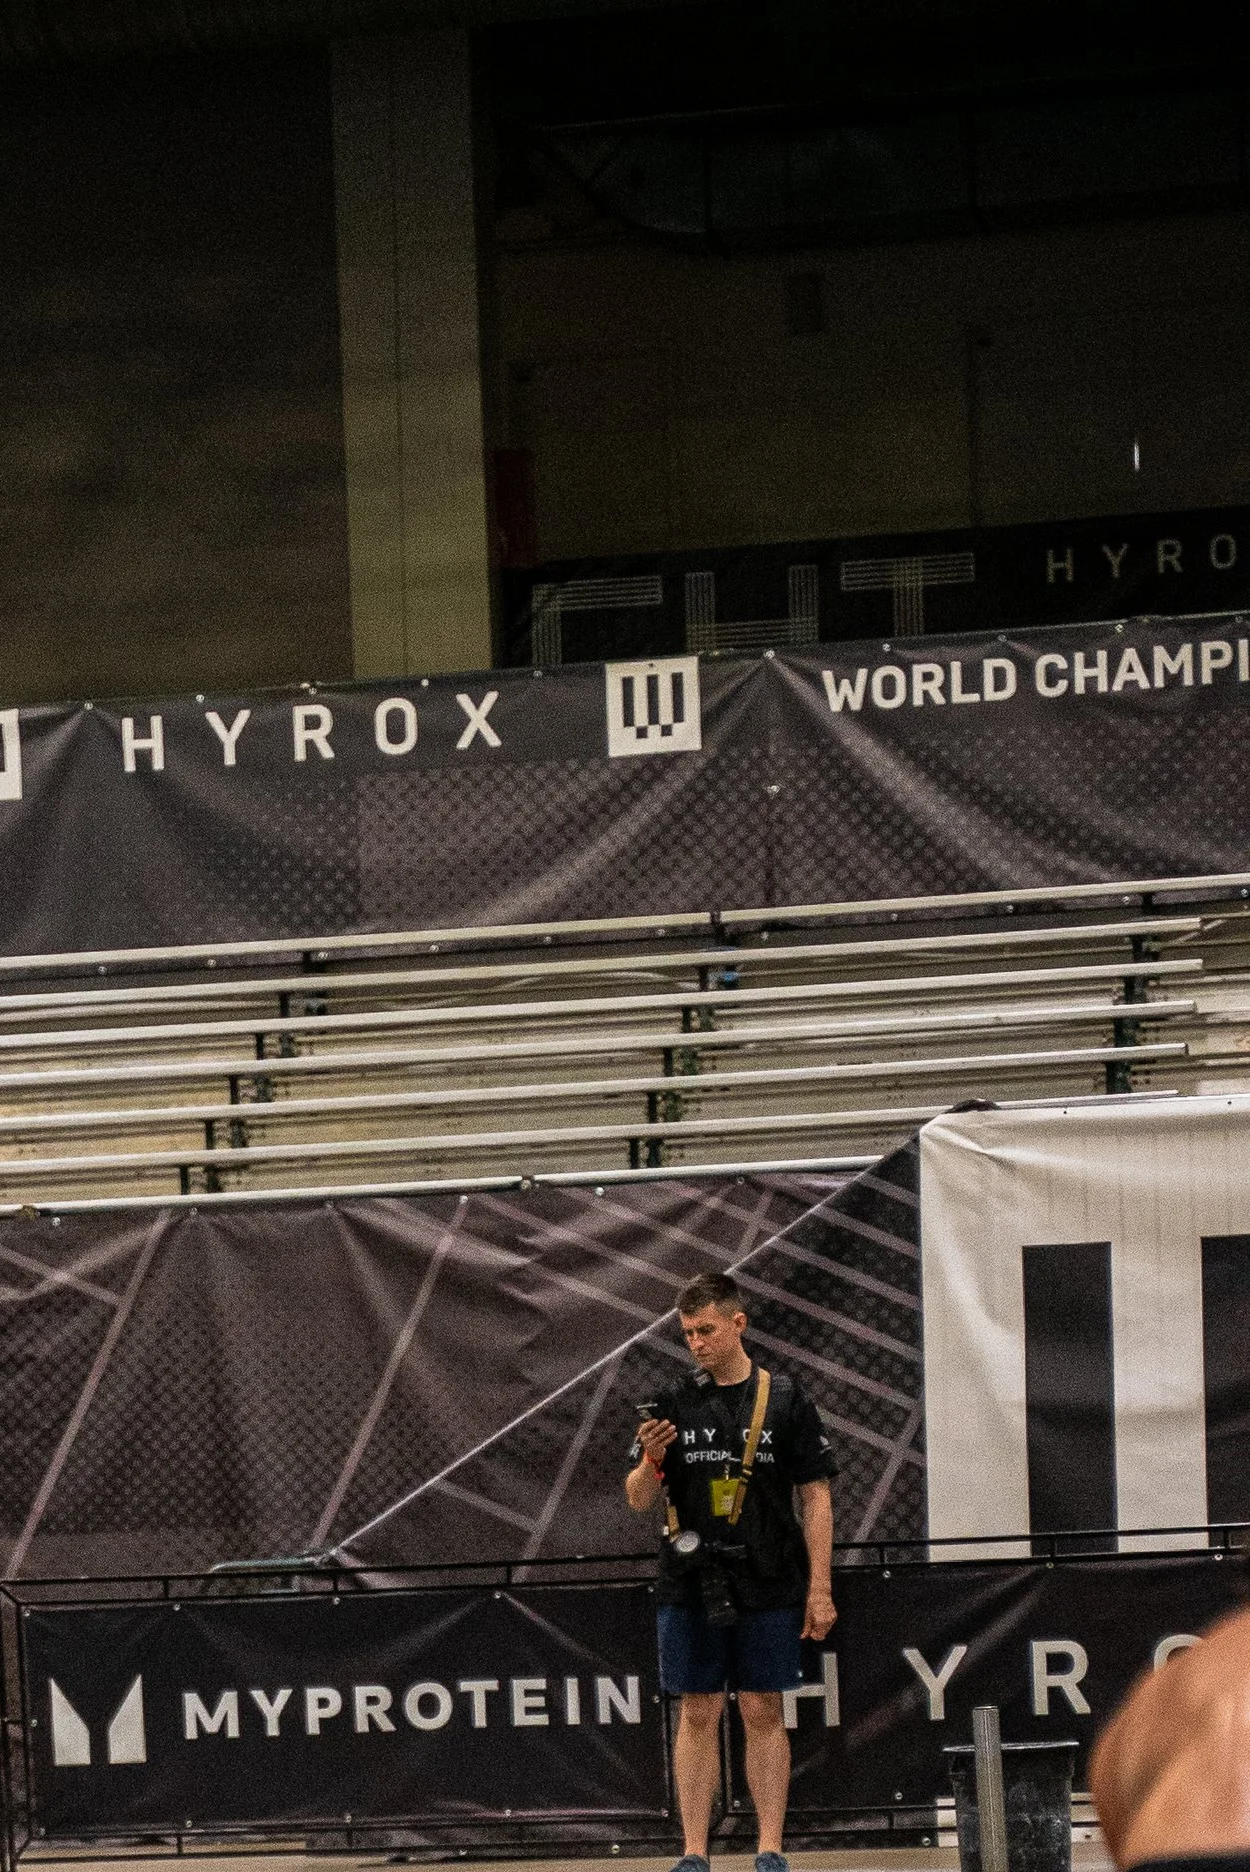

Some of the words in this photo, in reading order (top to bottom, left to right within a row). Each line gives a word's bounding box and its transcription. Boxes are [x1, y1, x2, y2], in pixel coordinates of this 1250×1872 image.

[1047, 533, 1238, 583] HYRO
[822, 657, 1018, 712] WORLD
[1035, 639, 1250, 698] CHAMPI
[122, 690, 502, 772] HYROX
[183, 1675, 641, 1739] MYPROTEIN
